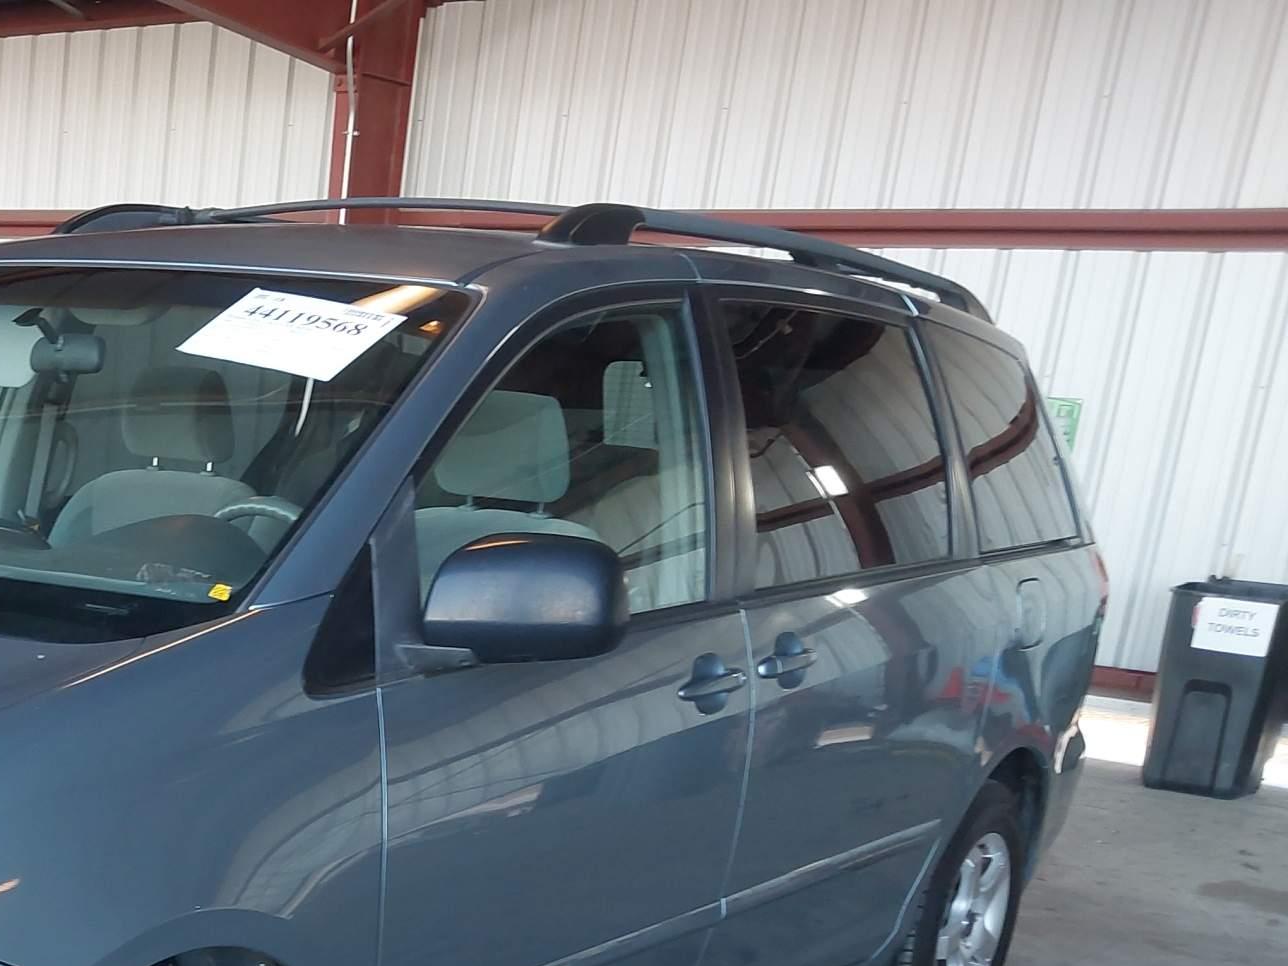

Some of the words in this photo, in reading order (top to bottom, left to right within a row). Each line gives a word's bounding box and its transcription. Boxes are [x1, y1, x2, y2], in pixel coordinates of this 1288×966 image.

[244, 305, 368, 335] 44119568
[1217, 607, 1257, 621] DIRTY
[1207, 622, 1260, 638] TOWELS
